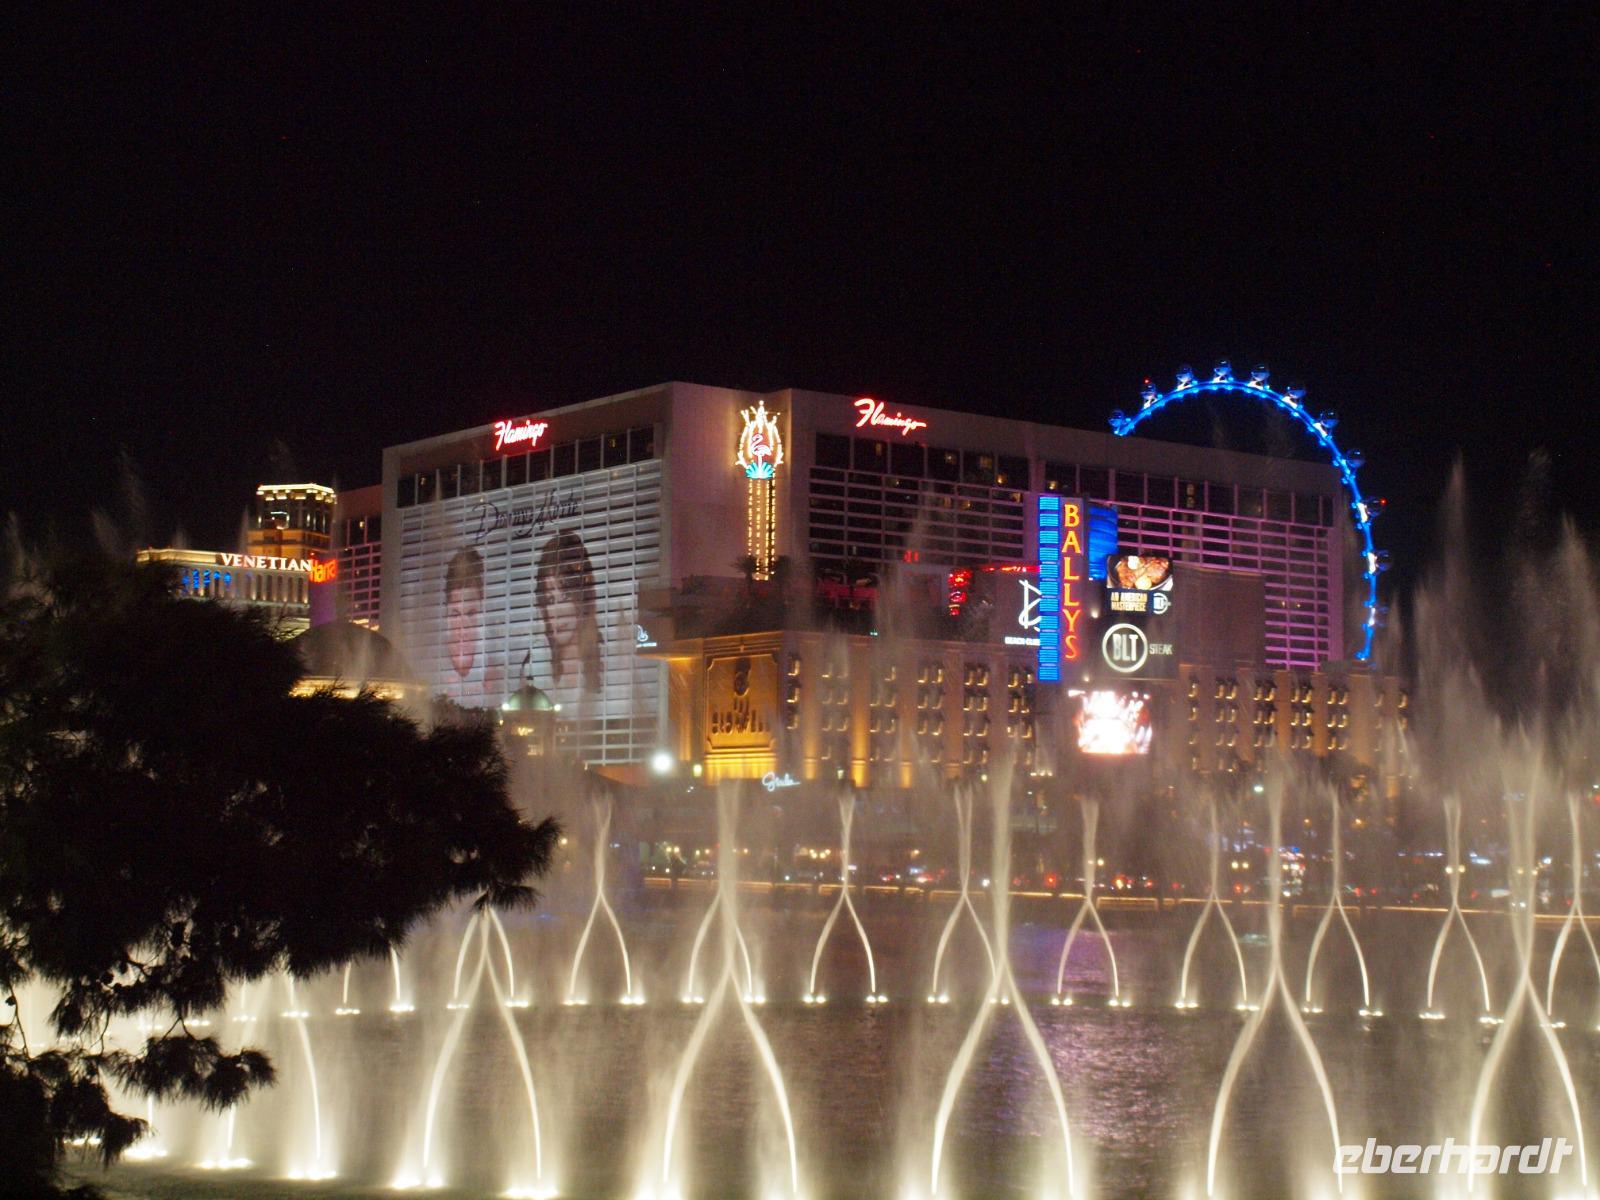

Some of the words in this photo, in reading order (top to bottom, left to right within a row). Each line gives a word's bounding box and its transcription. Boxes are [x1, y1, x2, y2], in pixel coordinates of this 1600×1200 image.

[854, 397, 927, 435] Flamingo
[494, 419, 548, 451] Flamingo
[220, 552, 313, 572] VENETIAN
[1112, 633, 1139, 662] BLT
[1149, 643, 1173, 655] STEAK
